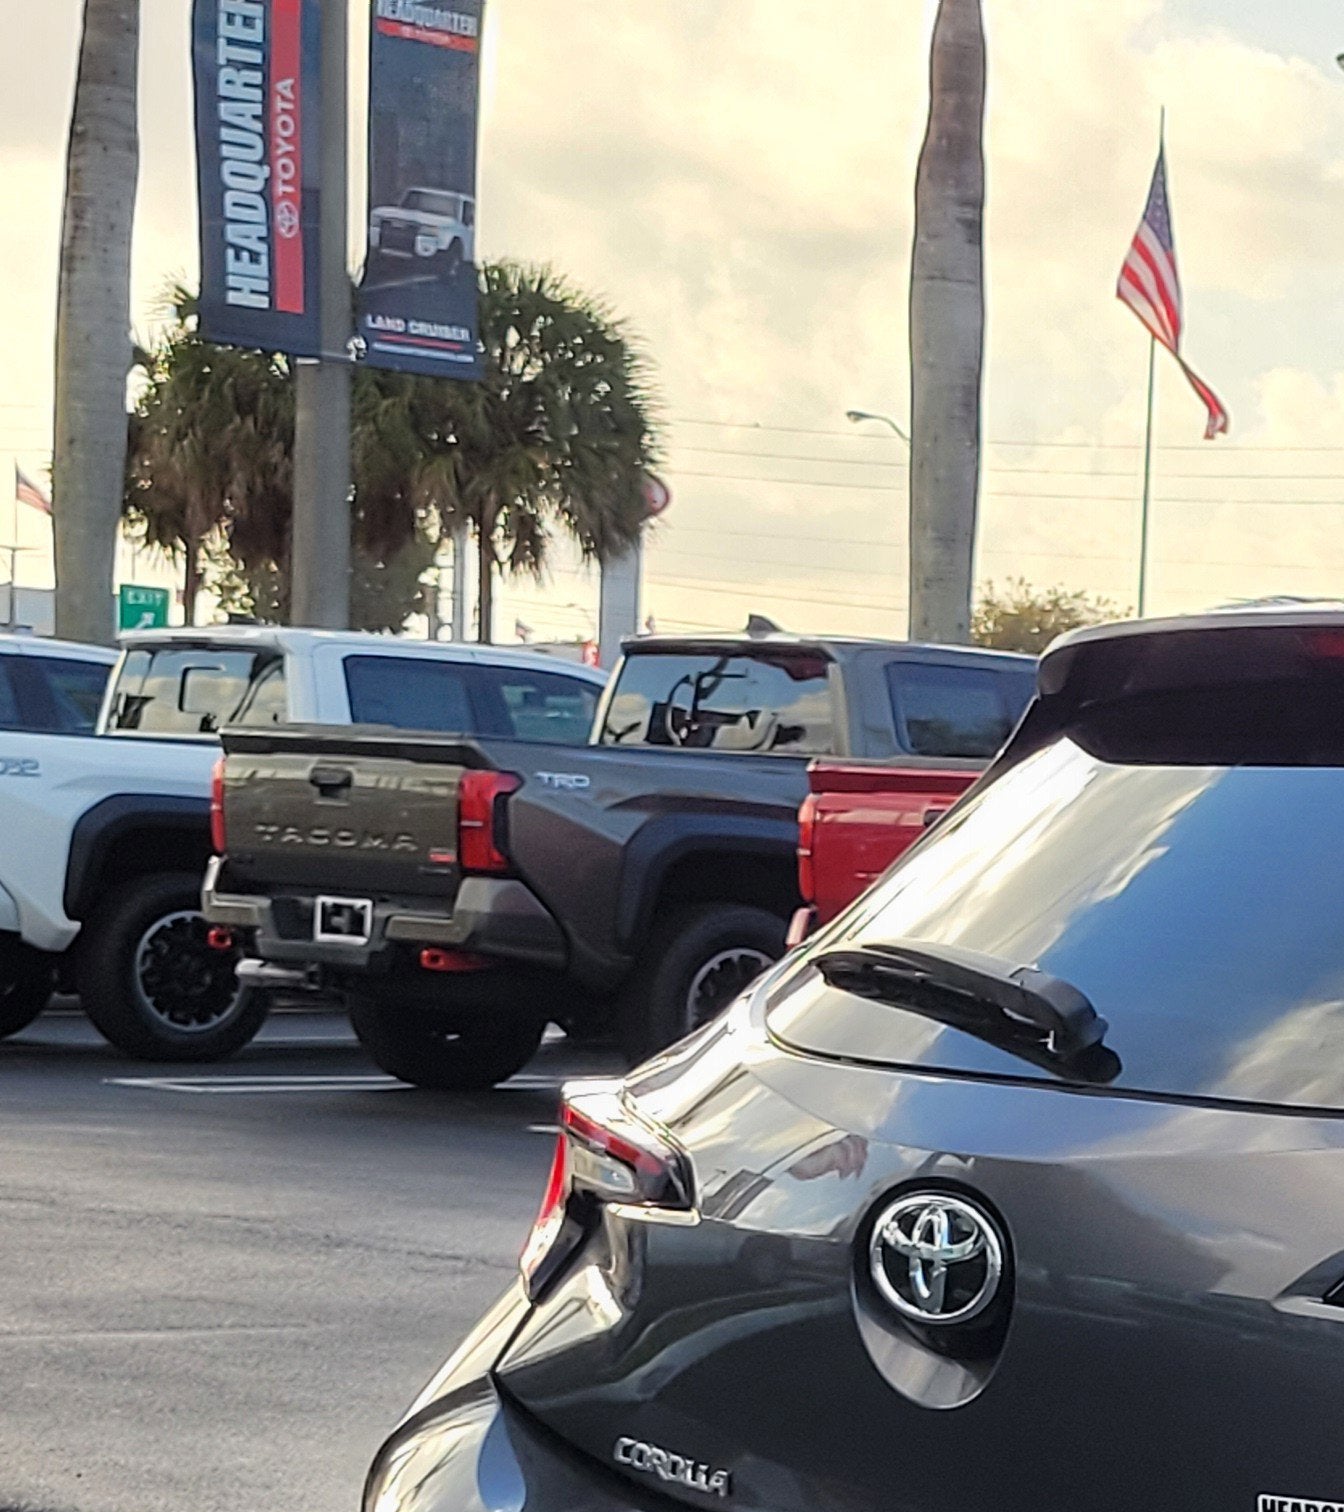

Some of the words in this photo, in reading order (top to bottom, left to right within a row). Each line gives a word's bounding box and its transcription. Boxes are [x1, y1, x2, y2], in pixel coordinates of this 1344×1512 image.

[275, 78, 296, 197] TOYOTA
[366, 313, 406, 333] LAND
[534, 771, 590, 788] TRD
[254, 823, 418, 851] TACOMA
[613, 1436, 729, 1498] COROLLA
